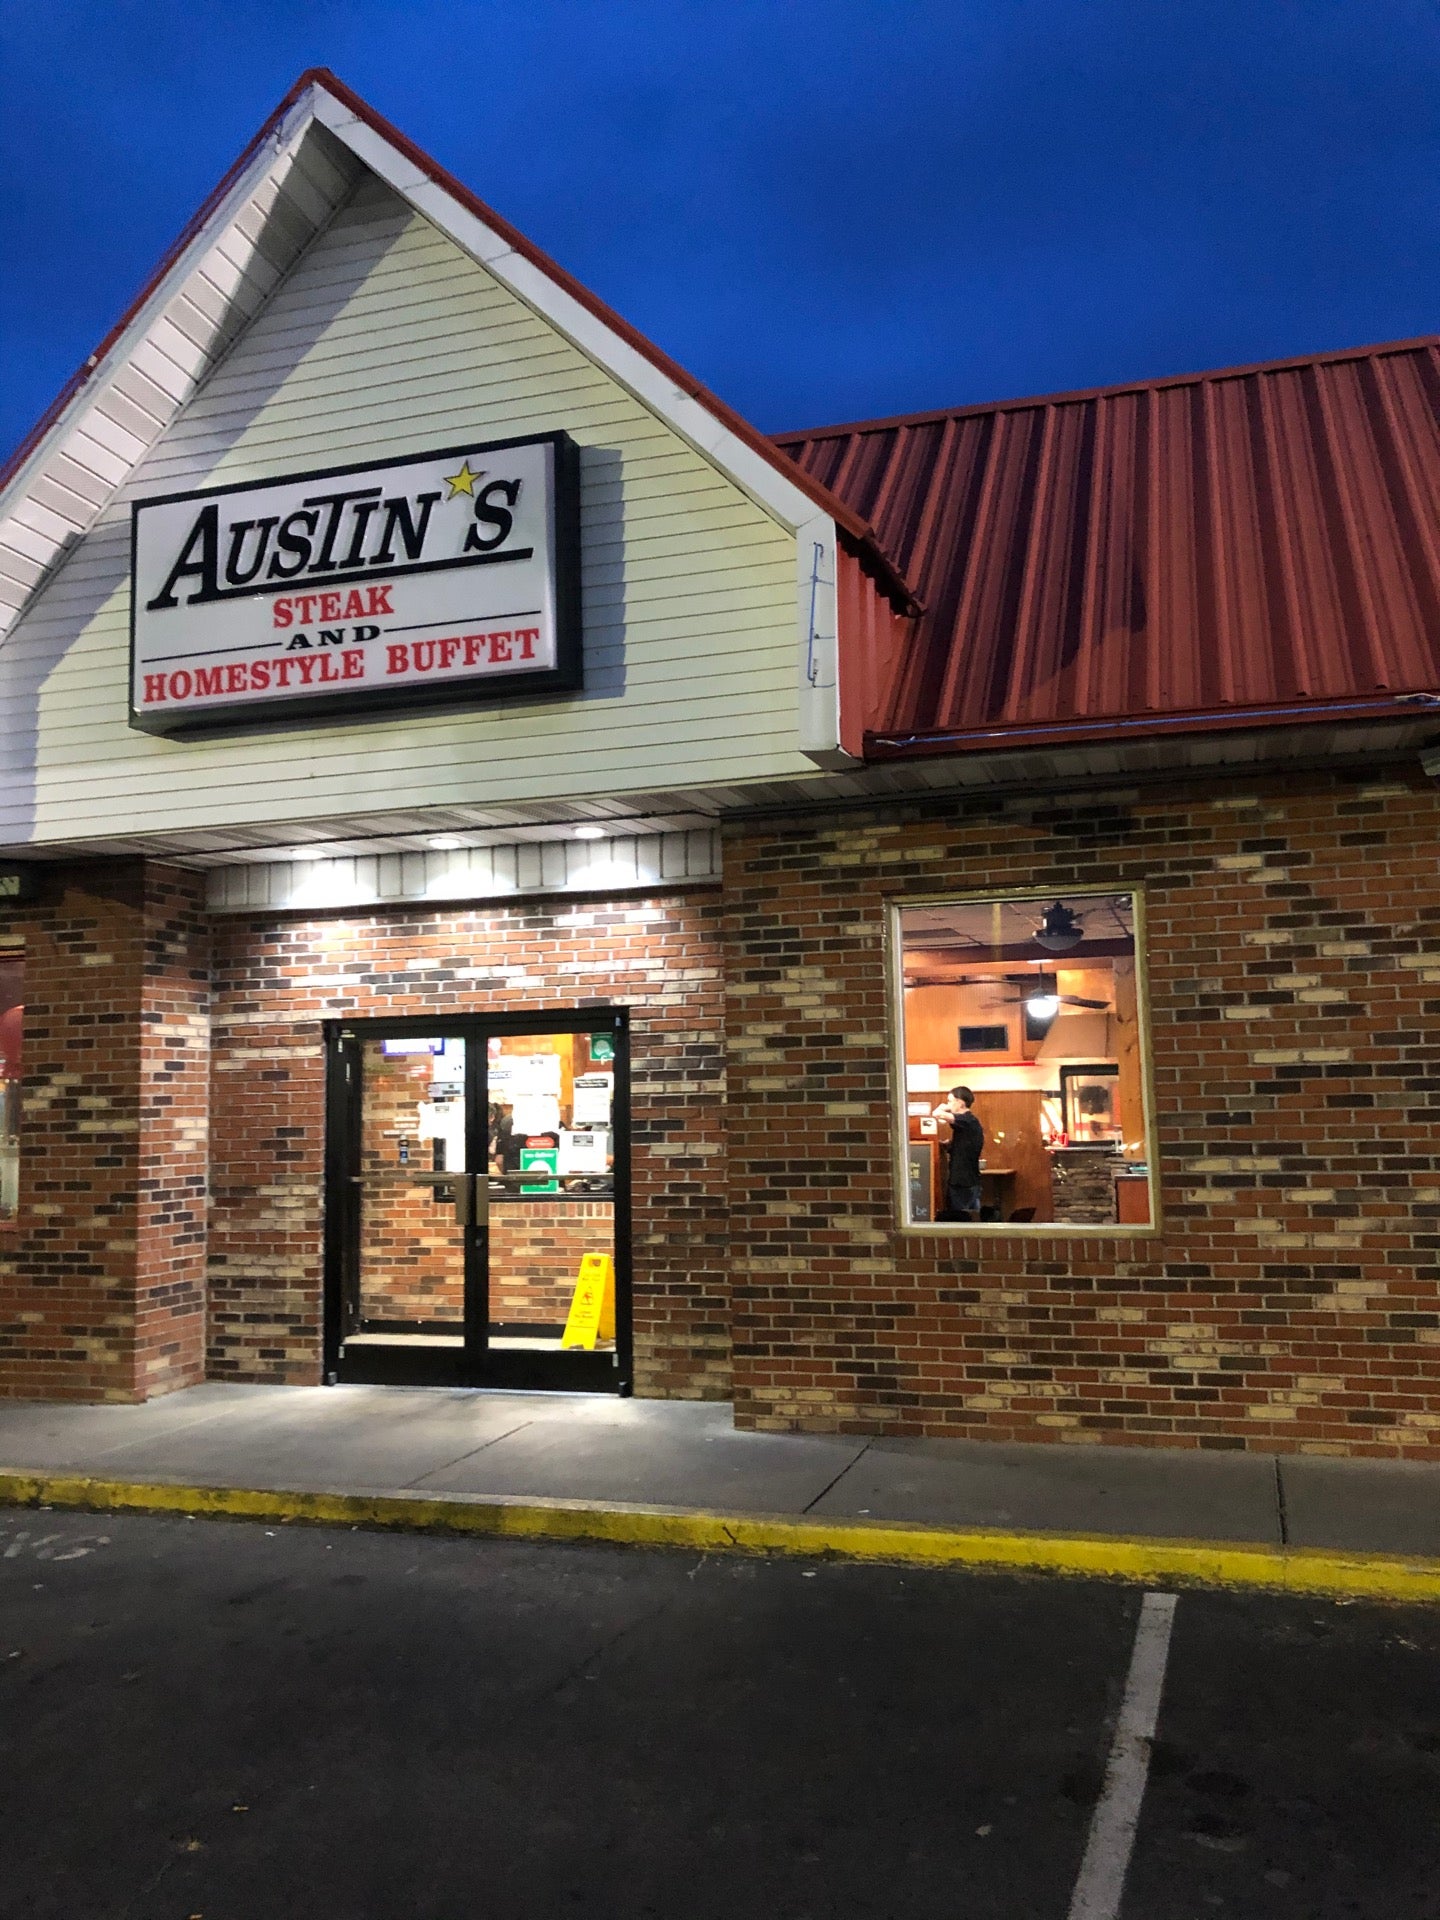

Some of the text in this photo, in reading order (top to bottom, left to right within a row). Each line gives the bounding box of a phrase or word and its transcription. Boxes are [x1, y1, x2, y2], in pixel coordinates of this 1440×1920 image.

[273, 585, 394, 629] STEAK
[285, 624, 382, 650] AND
[143, 628, 541, 703] HOMESTYLE BUFFET
